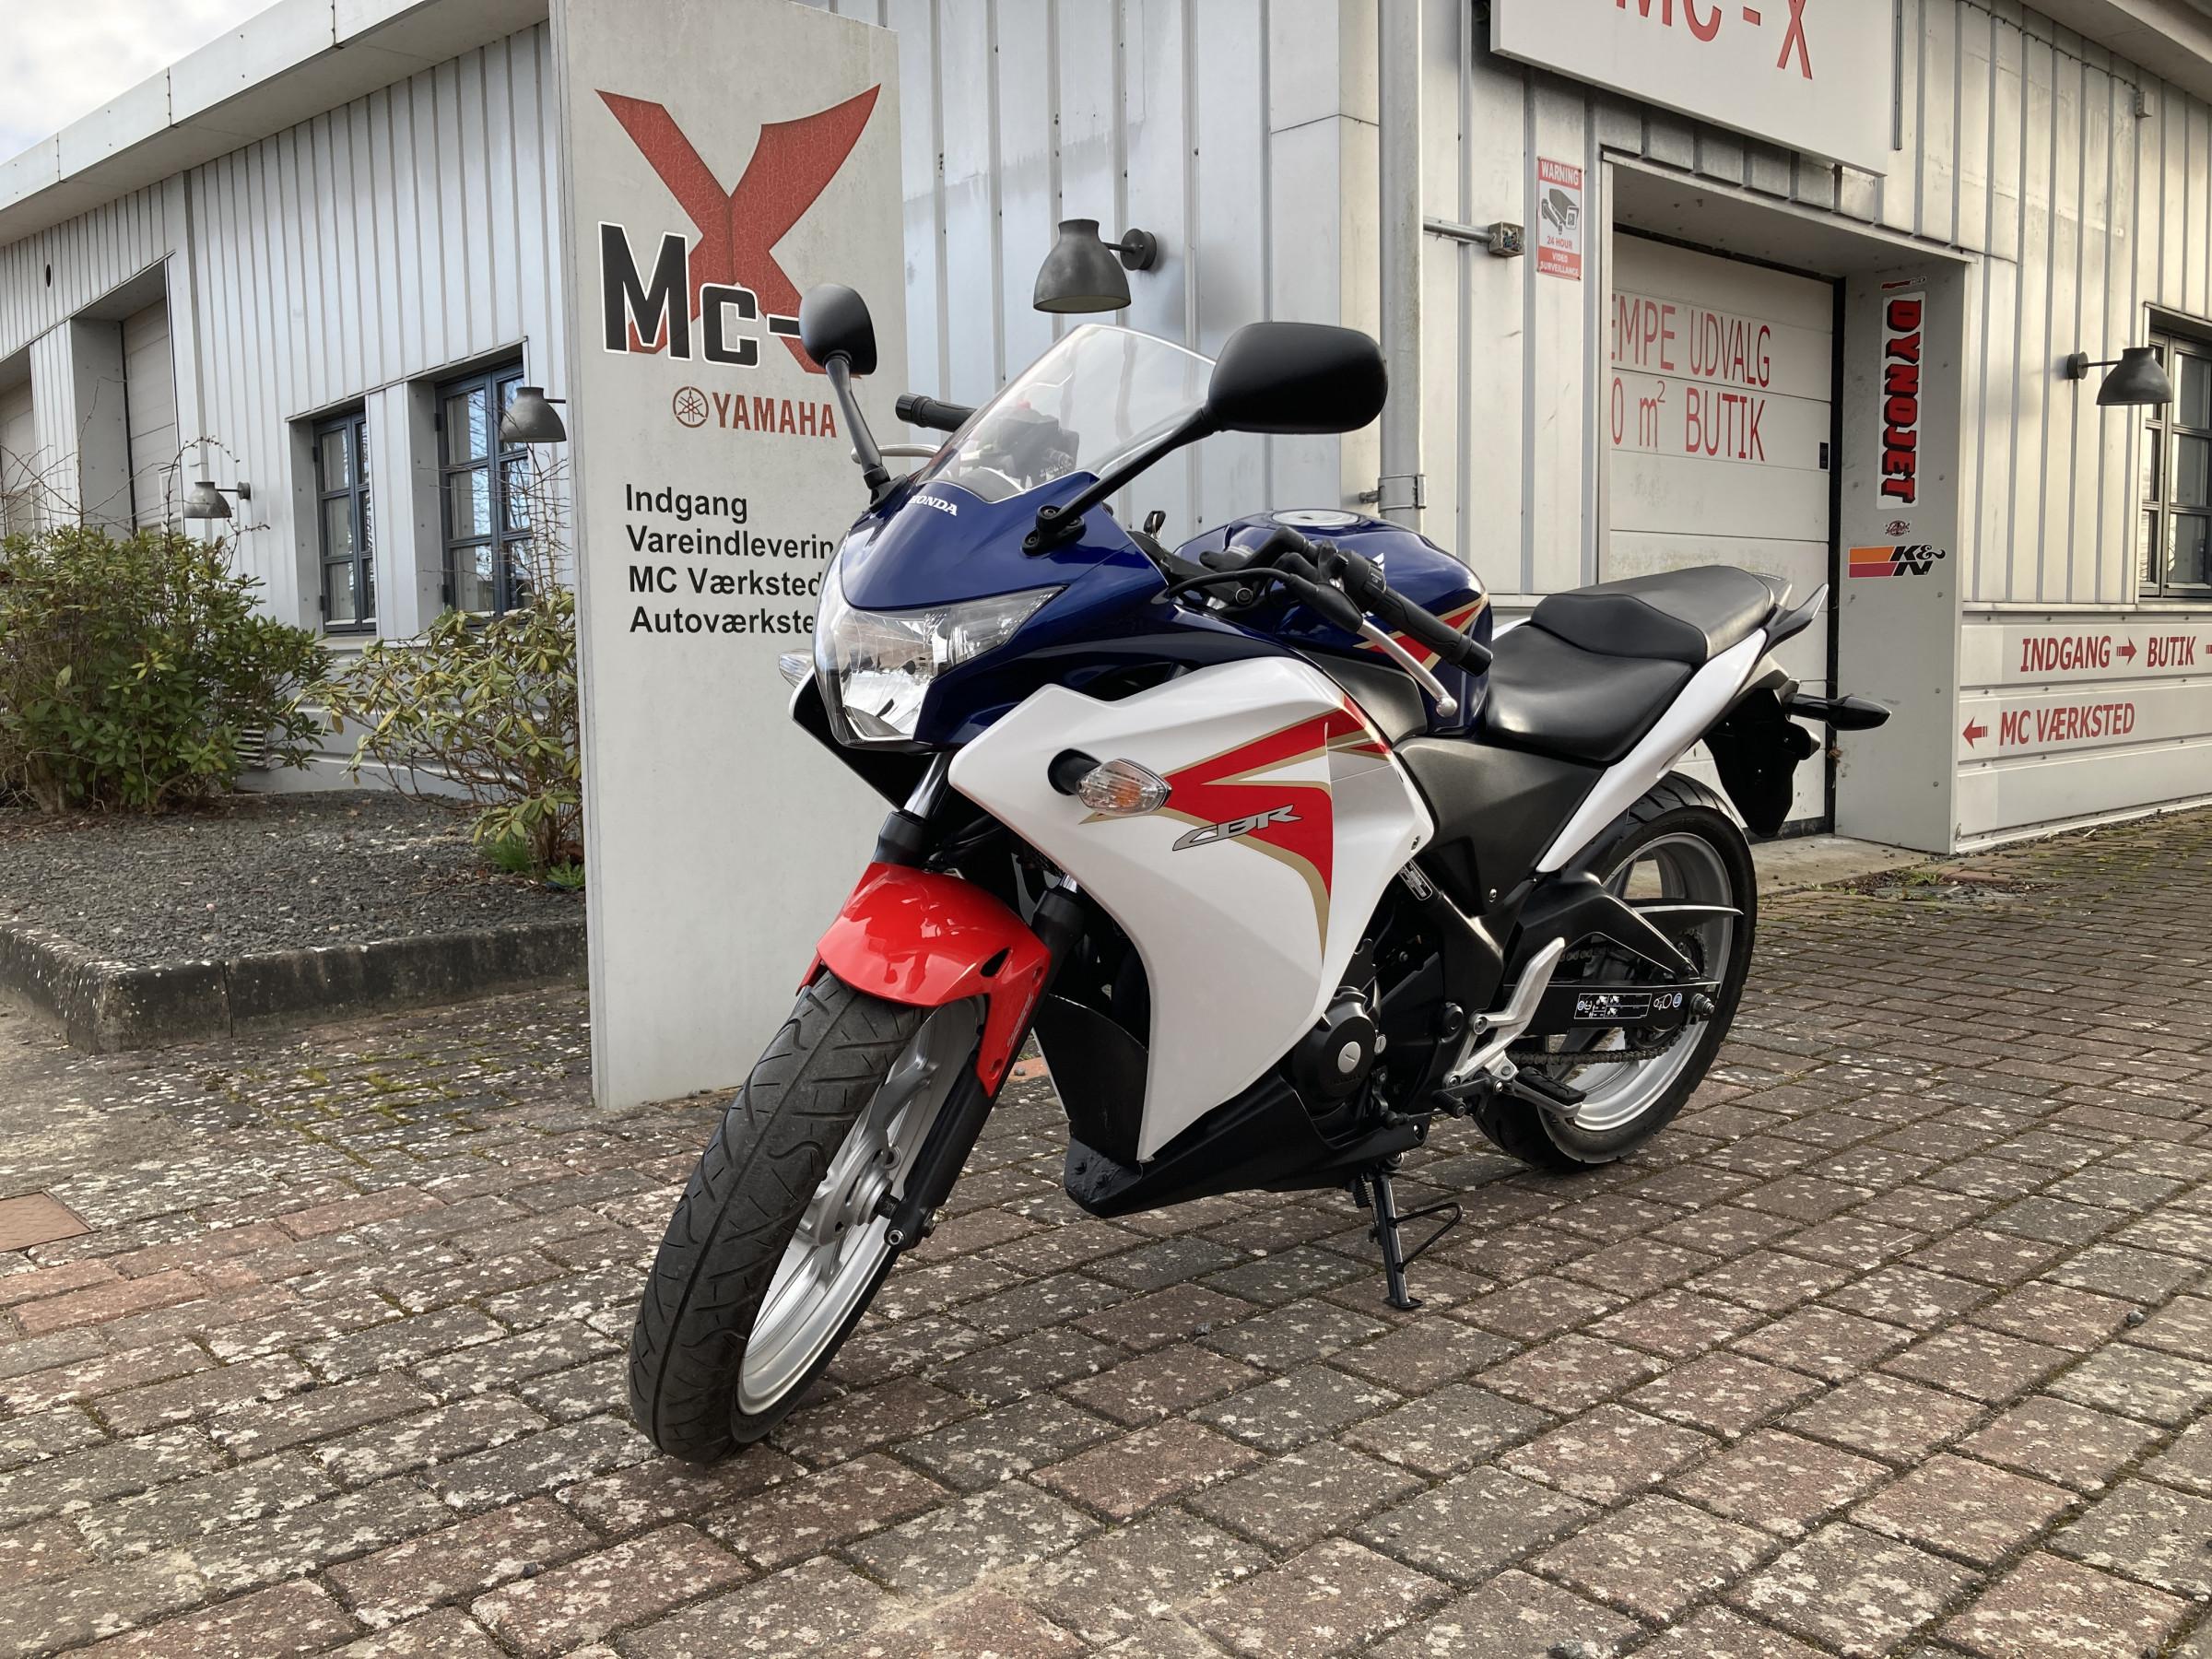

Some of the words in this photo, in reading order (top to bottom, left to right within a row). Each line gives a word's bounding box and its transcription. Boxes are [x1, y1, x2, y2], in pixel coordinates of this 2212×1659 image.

[1541, 160, 1579, 186] WARNING
[1547, 235, 1555, 245] 24
[1556, 237, 1572, 250] HOUR
[1551, 252, 1569, 264] VIDEO
[1540, 261, 1579, 276] SURVEILLANCE
[1612, 293, 1676, 371] MPE
[1690, 309, 1771, 388] UDVALG
[712, 391, 837, 438] YAMAHA
[1881, 299, 1922, 504] DYNOJET
[1686, 386, 1766, 462] BUTIK
[626, 483, 747, 524] Indgang
[625, 524, 834, 559] Vareindleverin
[629, 565, 677, 594] MC
[687, 567, 822, 596] Værksted
[2020, 635, 2112, 672] INDGANG
[2147, 636, 2197, 667] BUTIK
[1999, 710, 2031, 747] MC
[2036, 702, 2136, 743] VÆRKSTED
[1172, 804, 1303, 852] CBR
